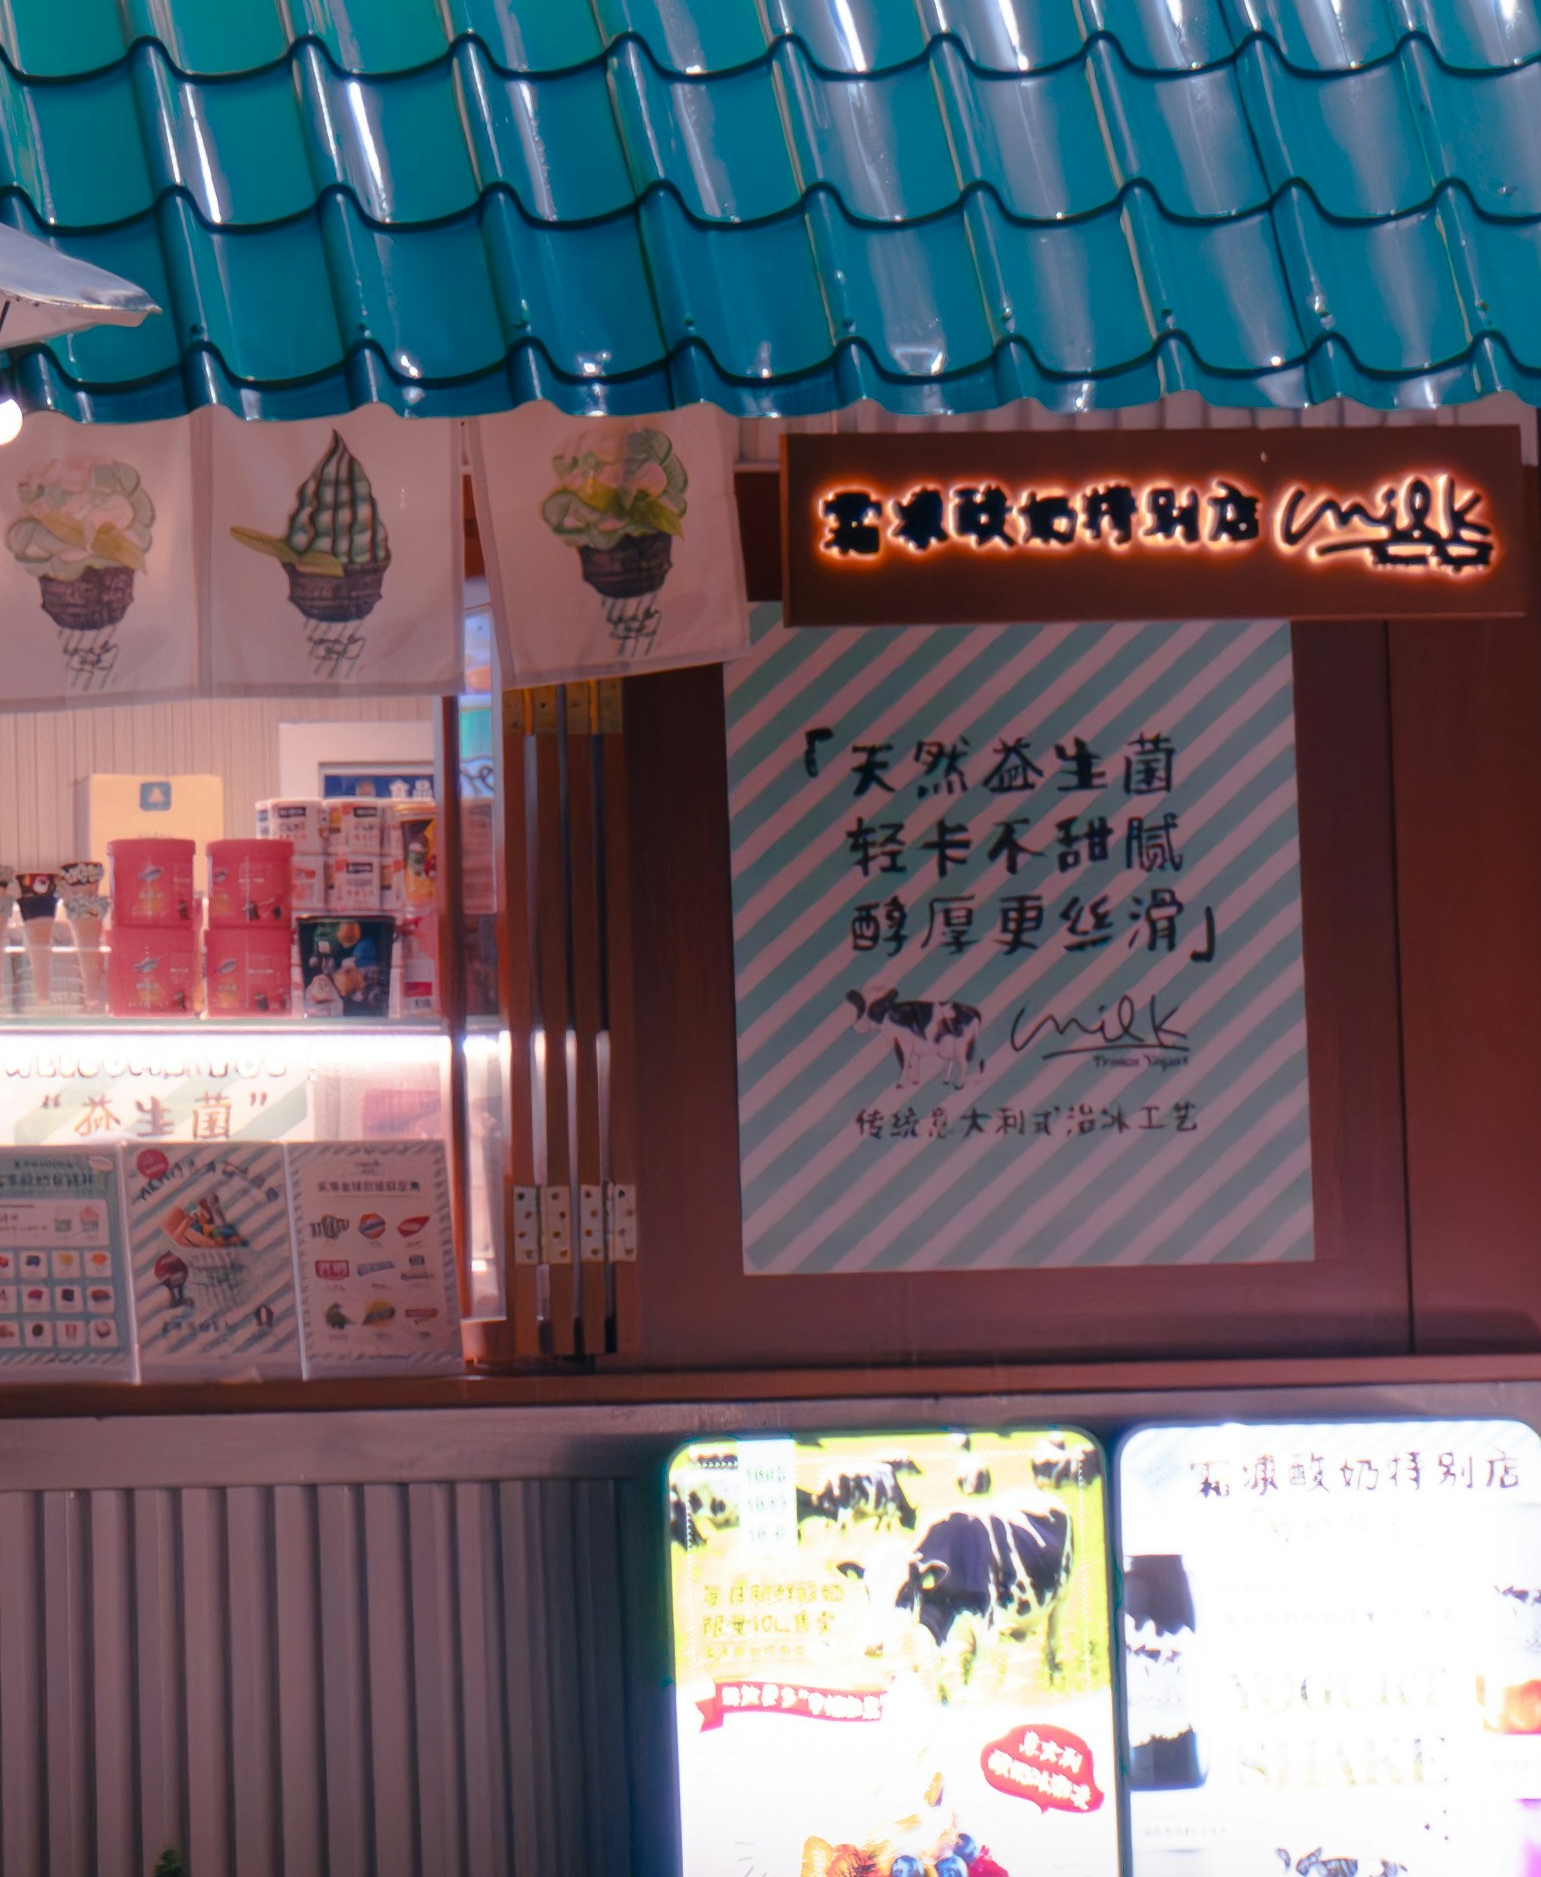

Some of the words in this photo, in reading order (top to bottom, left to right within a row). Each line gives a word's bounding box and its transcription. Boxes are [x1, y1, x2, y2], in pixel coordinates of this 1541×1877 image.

[1283, 476, 1493, 548] milk
[846, 812, 1184, 878] 轻卡不甜腻
[1011, 994, 1188, 1052] milk
